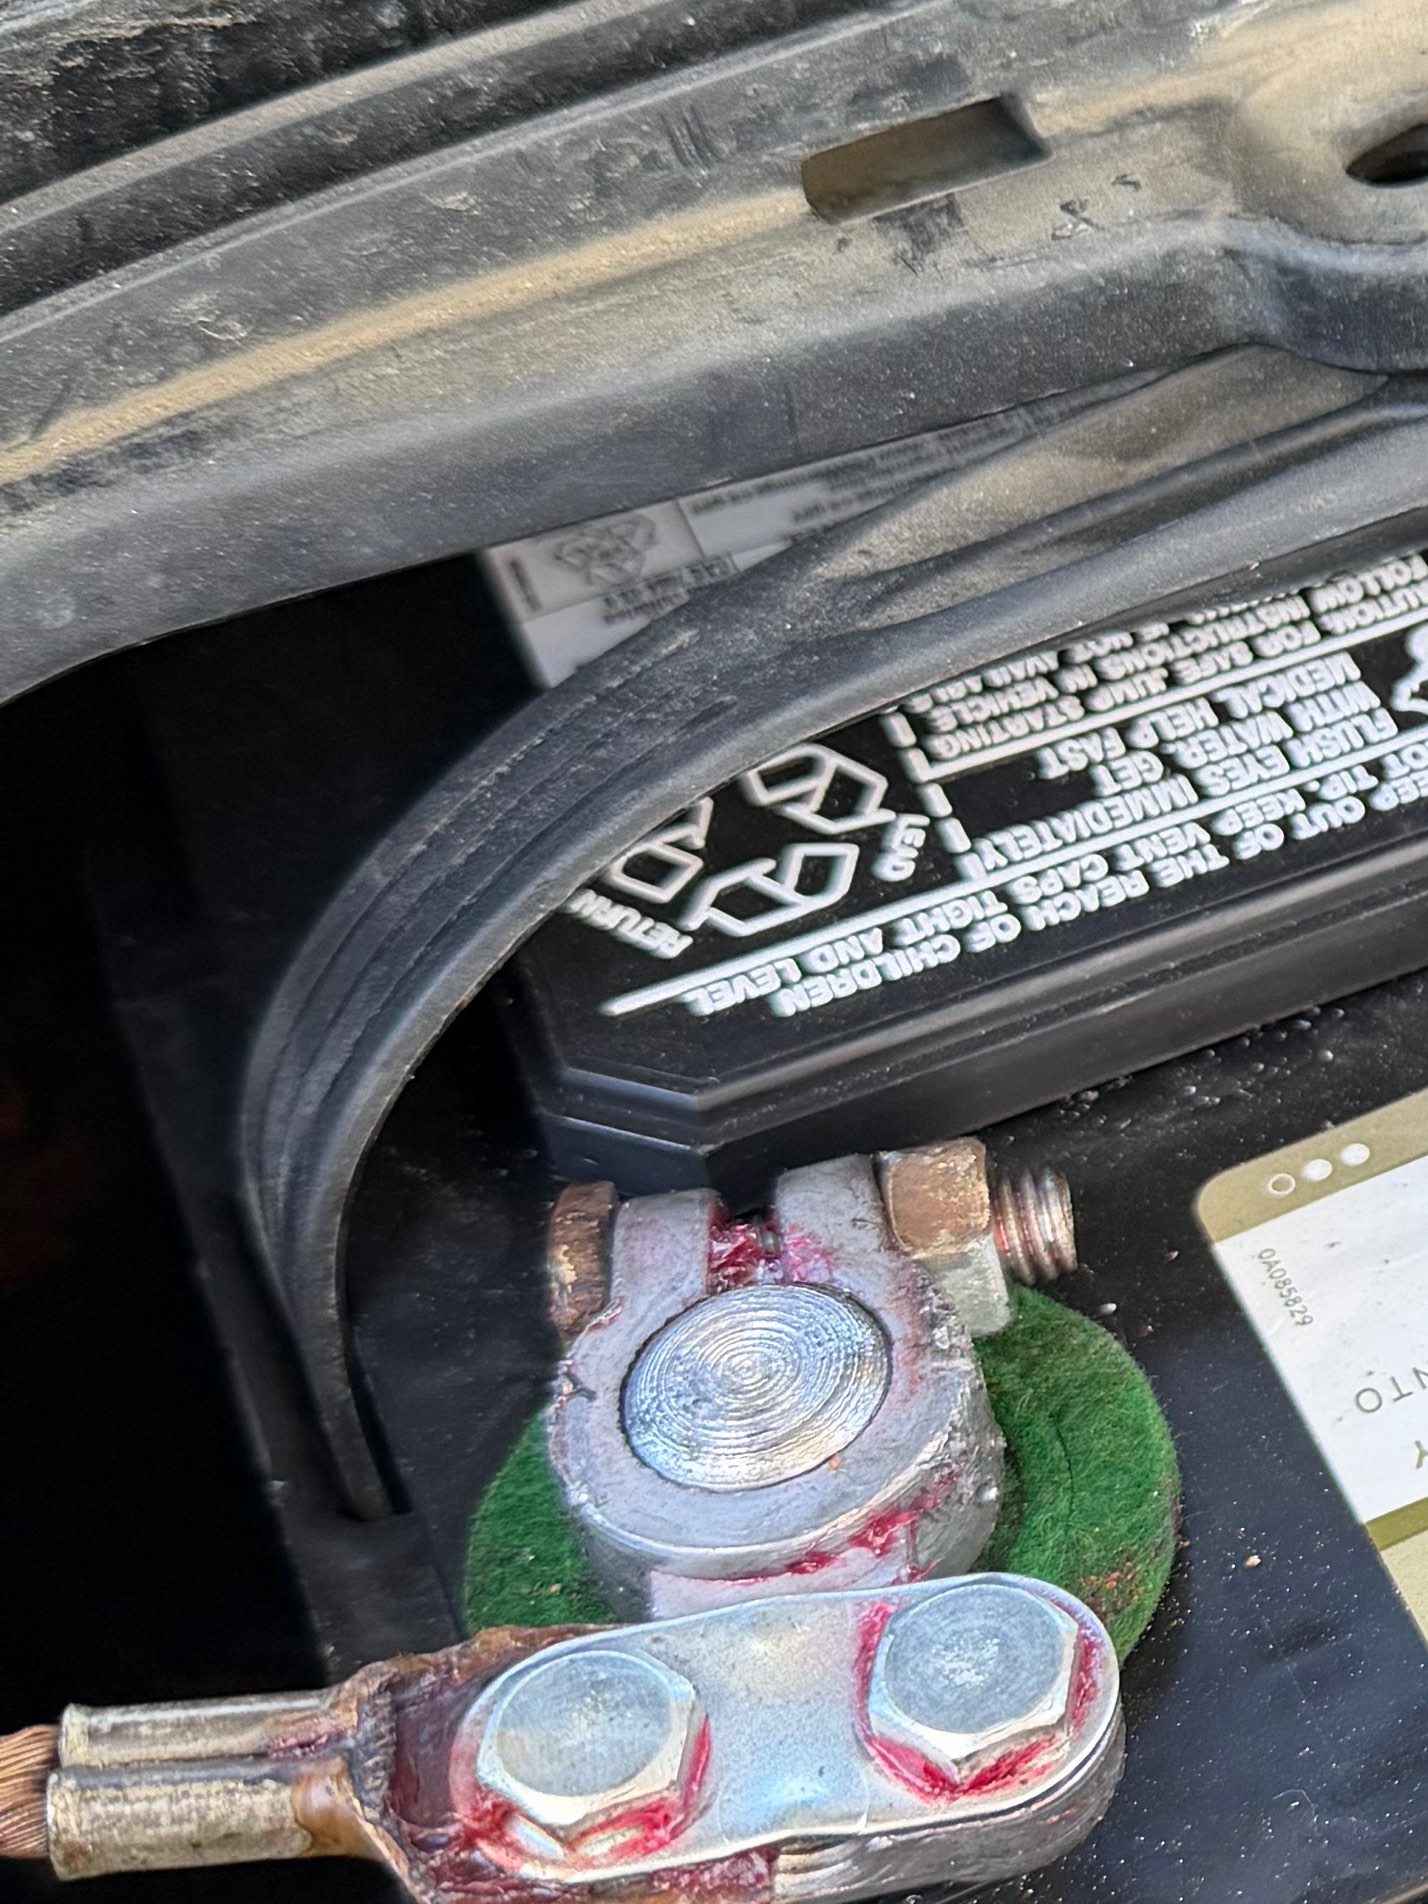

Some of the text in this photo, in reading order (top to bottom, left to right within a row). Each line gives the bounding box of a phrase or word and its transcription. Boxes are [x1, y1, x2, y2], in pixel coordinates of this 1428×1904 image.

[1096, 595, 1311, 681] INSTRUCTIONS
[1172, 640, 1256, 687] SAFE
[1253, 620, 1324, 659] FOR
[920, 676, 1059, 733] VEHICLE
[1058, 664, 1098, 694] IN
[1087, 666, 1169, 713] JUMP
[926, 688, 1085, 765] STARTING
[1036, 651, 1362, 780] MEDICAL HELP FAST
[1090, 680, 1382, 798] WITH WATER. GET
[974, 707, 1402, 874] FLUSH EYES IMMEDIATELY
[1303, 764, 1379, 801] TIP.
[1207, 787, 1307, 836] KEEP
[1225, 817, 1285, 860] OF
[1285, 794, 1366, 841] OUT
[1114, 821, 1211, 872] VENT
[1135, 842, 1230, 892] THE
[1000, 850, 1114, 906] CAPS
[1020, 864, 1150, 931] REACH
[561, 885, 692, 960] RETURN
[883, 883, 1009, 947] TIGHT
[956, 910, 1022, 953] OF
[764, 933, 961, 1018] CHILDREN
[794, 925, 890, 982] AND
[674, 956, 806, 1016] LEVEL
[1256, 1248, 1314, 1327] 0A085829
